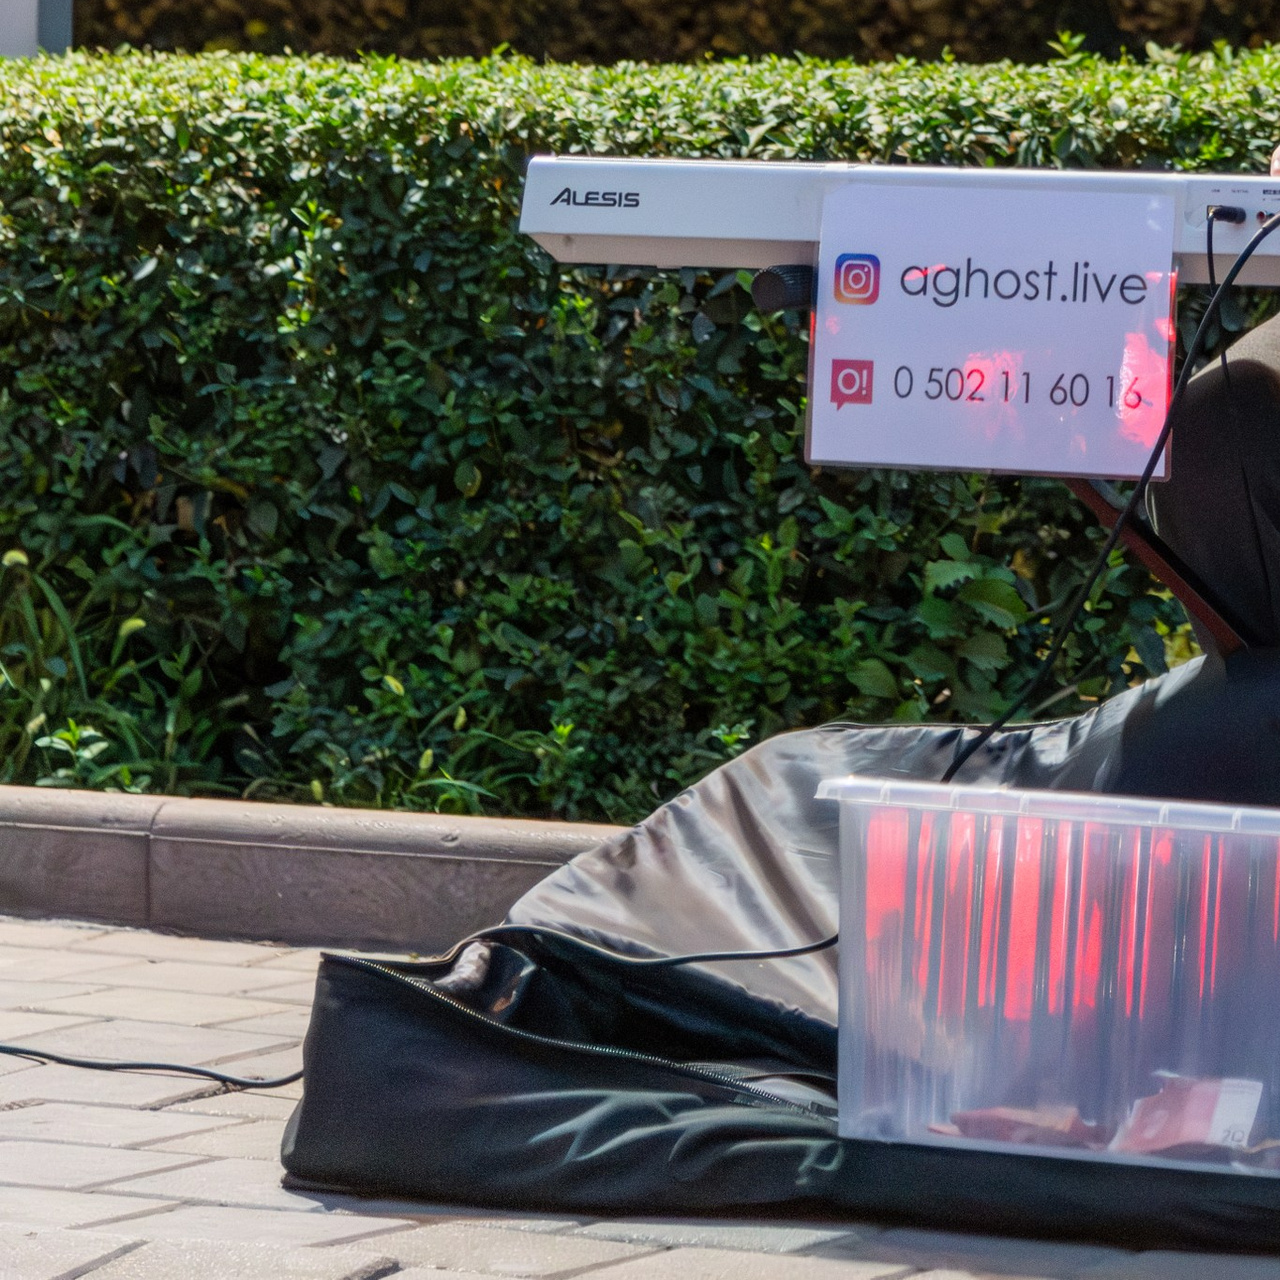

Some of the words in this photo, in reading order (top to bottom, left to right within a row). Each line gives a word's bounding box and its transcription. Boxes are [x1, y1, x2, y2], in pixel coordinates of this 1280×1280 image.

[549, 187, 640, 207] ALESIS
[900, 258, 1148, 308] aghost.live
[894, 366, 913, 399] 0
[925, 368, 985, 402] 502
[1001, 371, 1031, 404] 11
[1050, 373, 1089, 406] 60
[1106, 376, 1142, 409] 16
